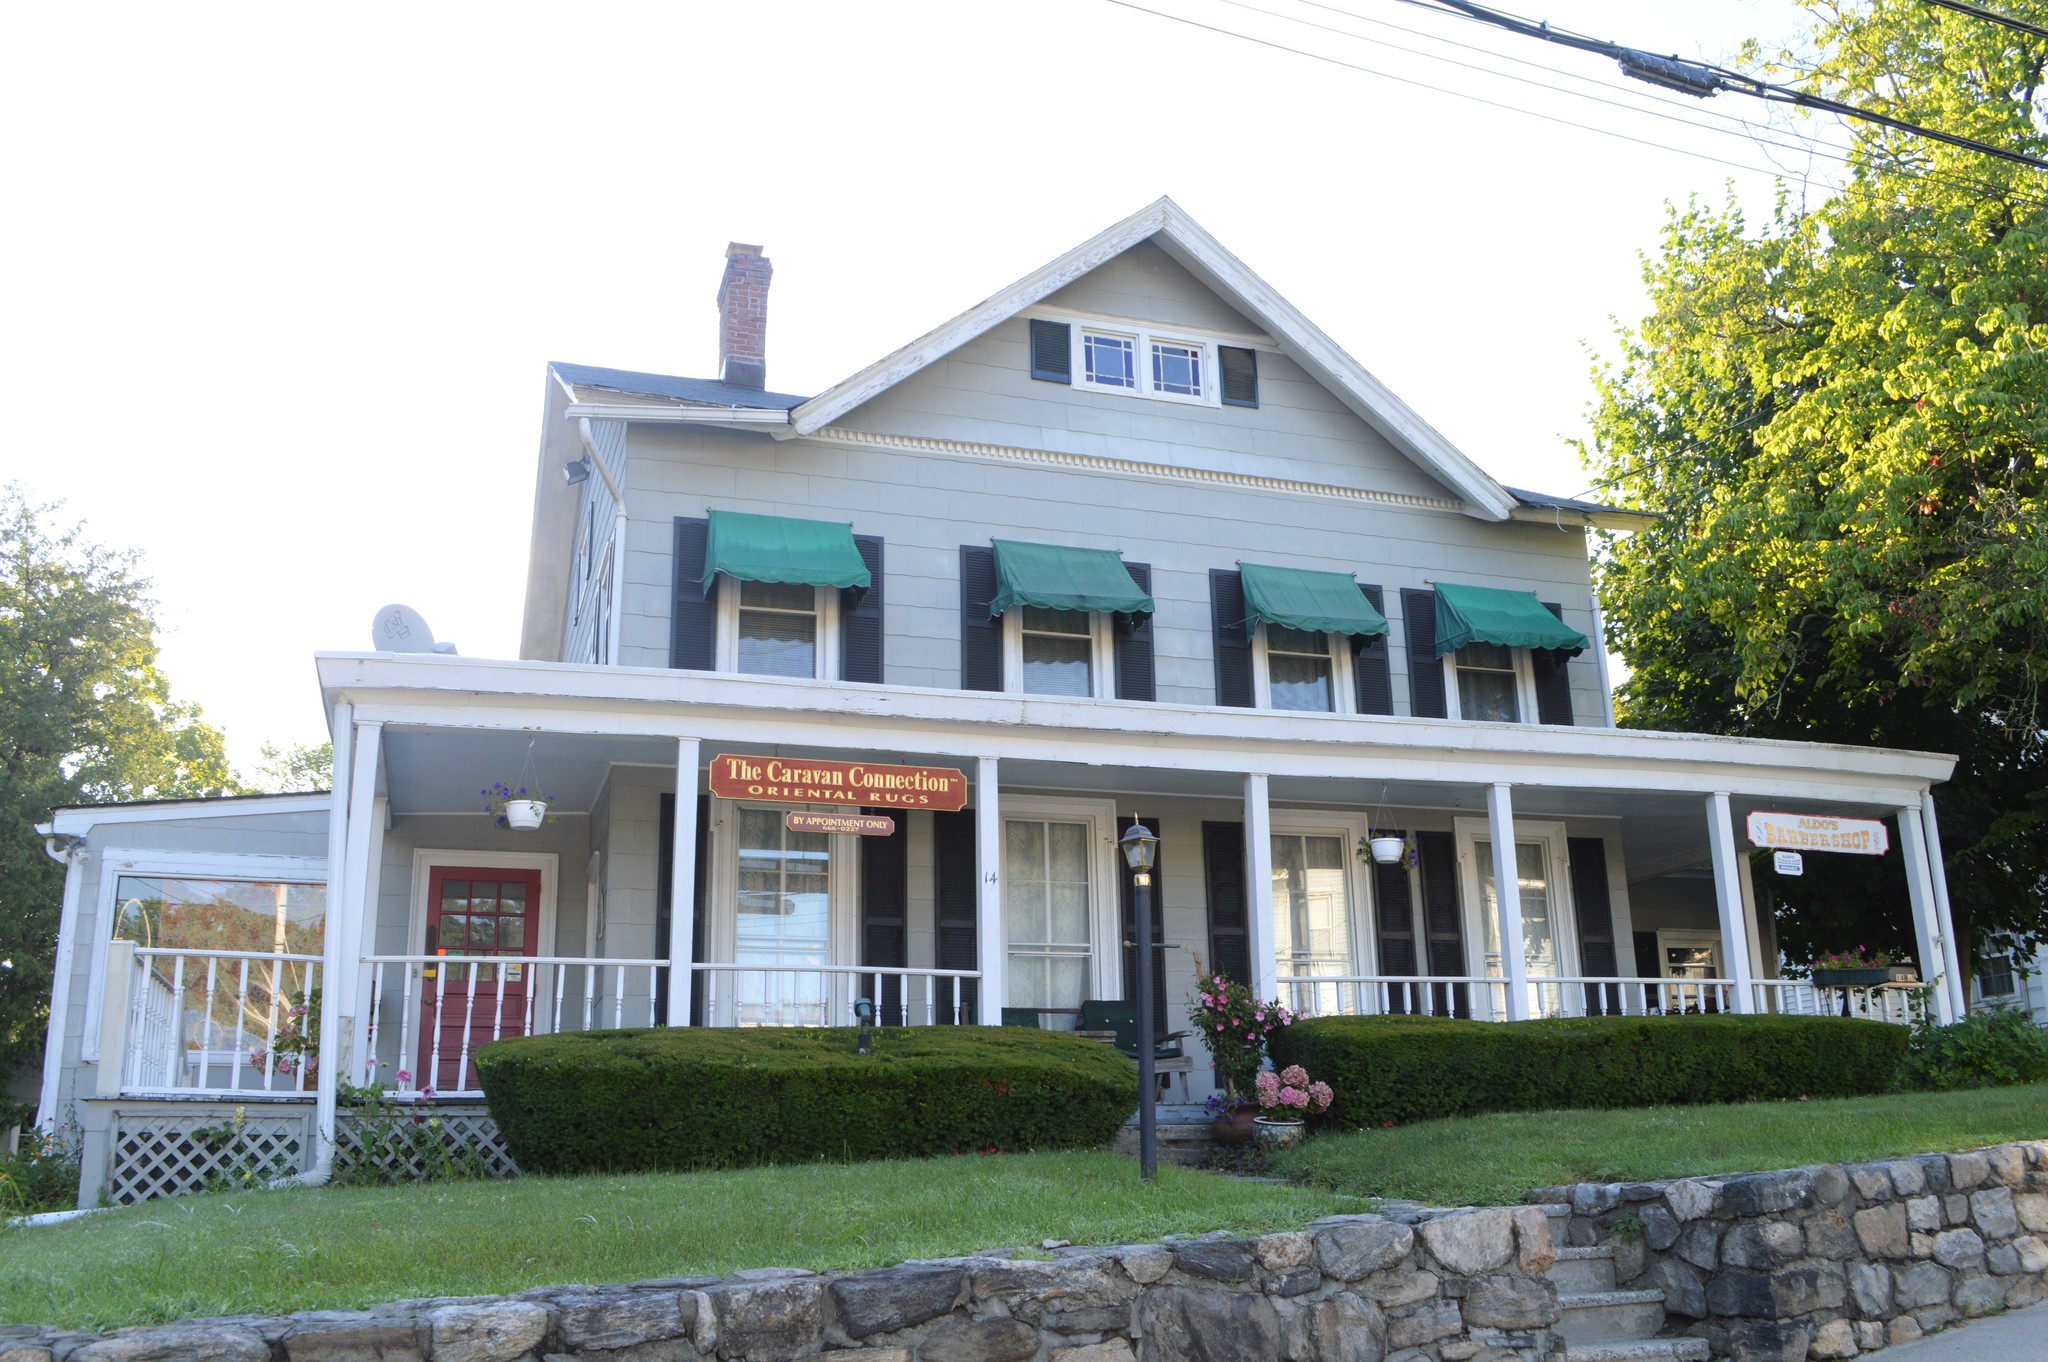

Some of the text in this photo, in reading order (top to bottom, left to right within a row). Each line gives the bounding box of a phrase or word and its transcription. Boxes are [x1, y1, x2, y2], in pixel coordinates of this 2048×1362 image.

[727, 759, 762, 781] The
[766, 761, 843, 786] Caravan
[849, 766, 949, 792] Connection
[748, 785, 929, 804] ORIENTAL RUGS
[793, 816, 888, 829] BY APPOINTMENT ONLY
[1799, 818, 1839, 830] ALDO'S
[985, 871, 998, 884] 14
